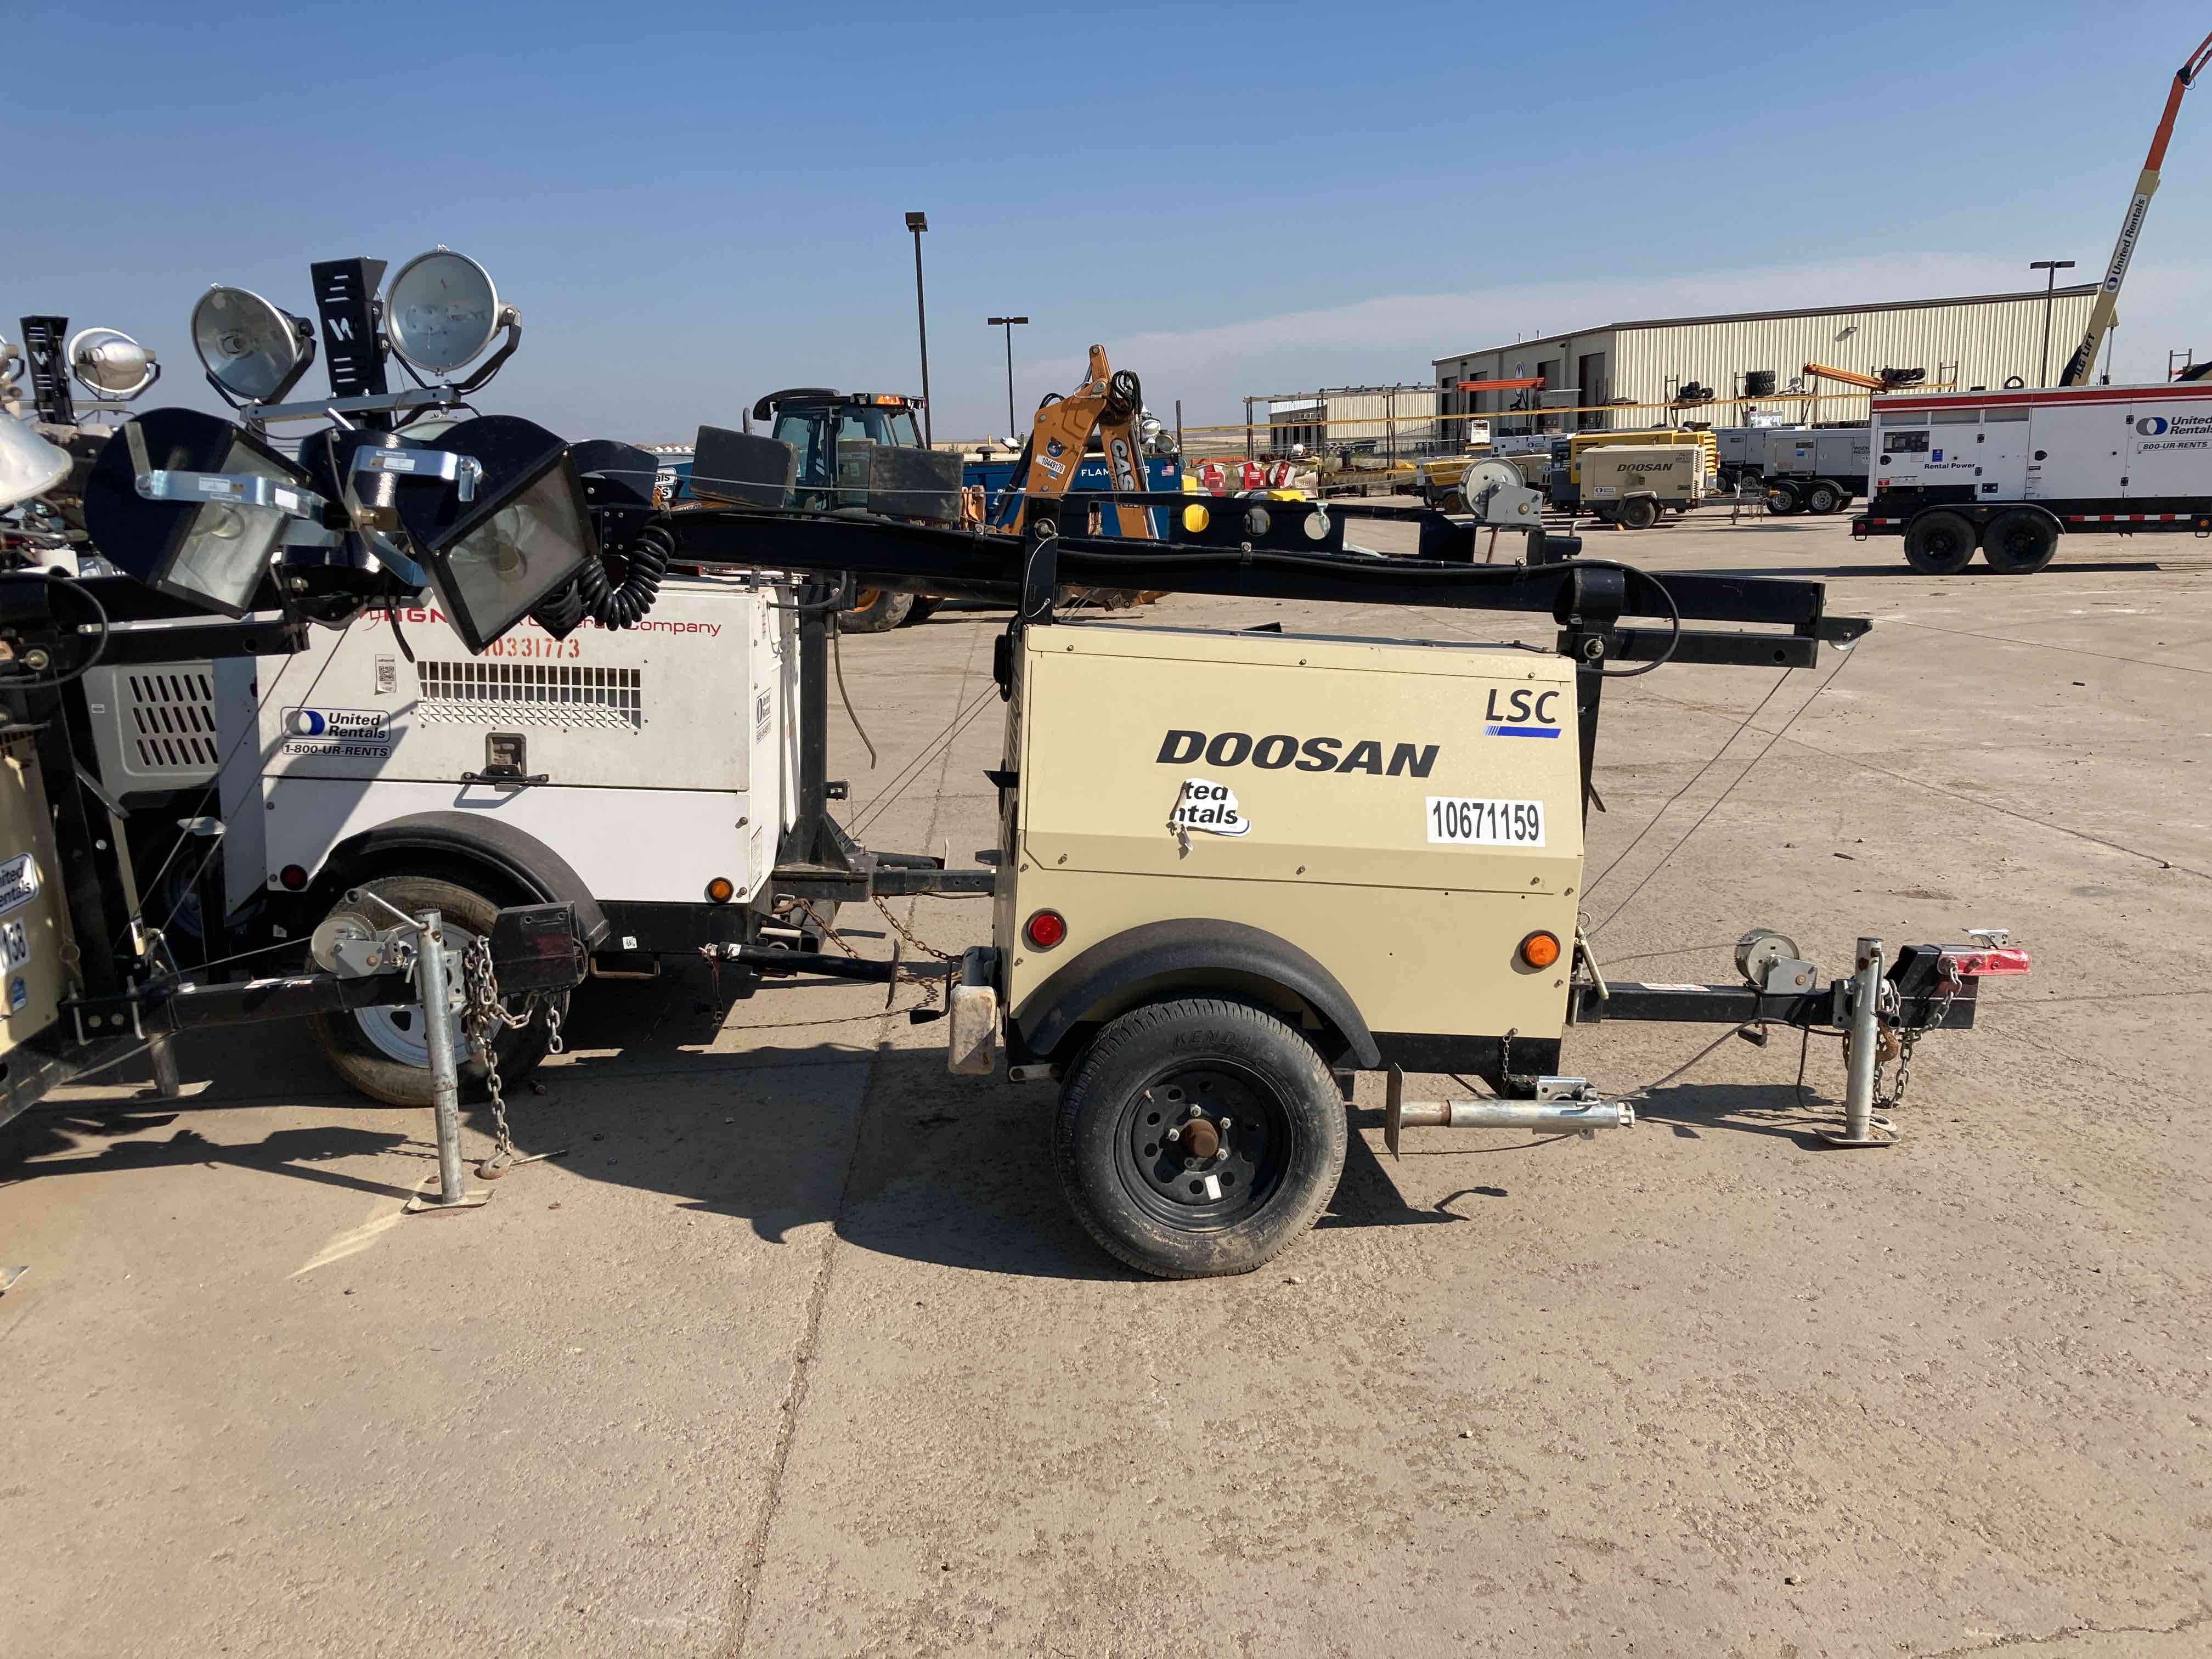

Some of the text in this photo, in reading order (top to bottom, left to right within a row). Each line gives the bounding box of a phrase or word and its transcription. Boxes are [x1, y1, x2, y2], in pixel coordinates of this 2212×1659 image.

[2112, 199, 2145, 274] United Rentals
[2075, 332, 2095, 379] JLG LIFT
[2171, 416, 2212, 425] United
[1111, 439, 1135, 492] CAS
[1617, 464, 1674, 472] DOOSAN
[329, 713, 381, 726] United
[1485, 688, 1560, 724] LSC
[329, 725, 386, 739] Rentals
[284, 744, 388, 757] 1-800-UR-RENTS
[1155, 730, 1440, 778] DOOSAN
[1433, 800, 1539, 841] 10671159
